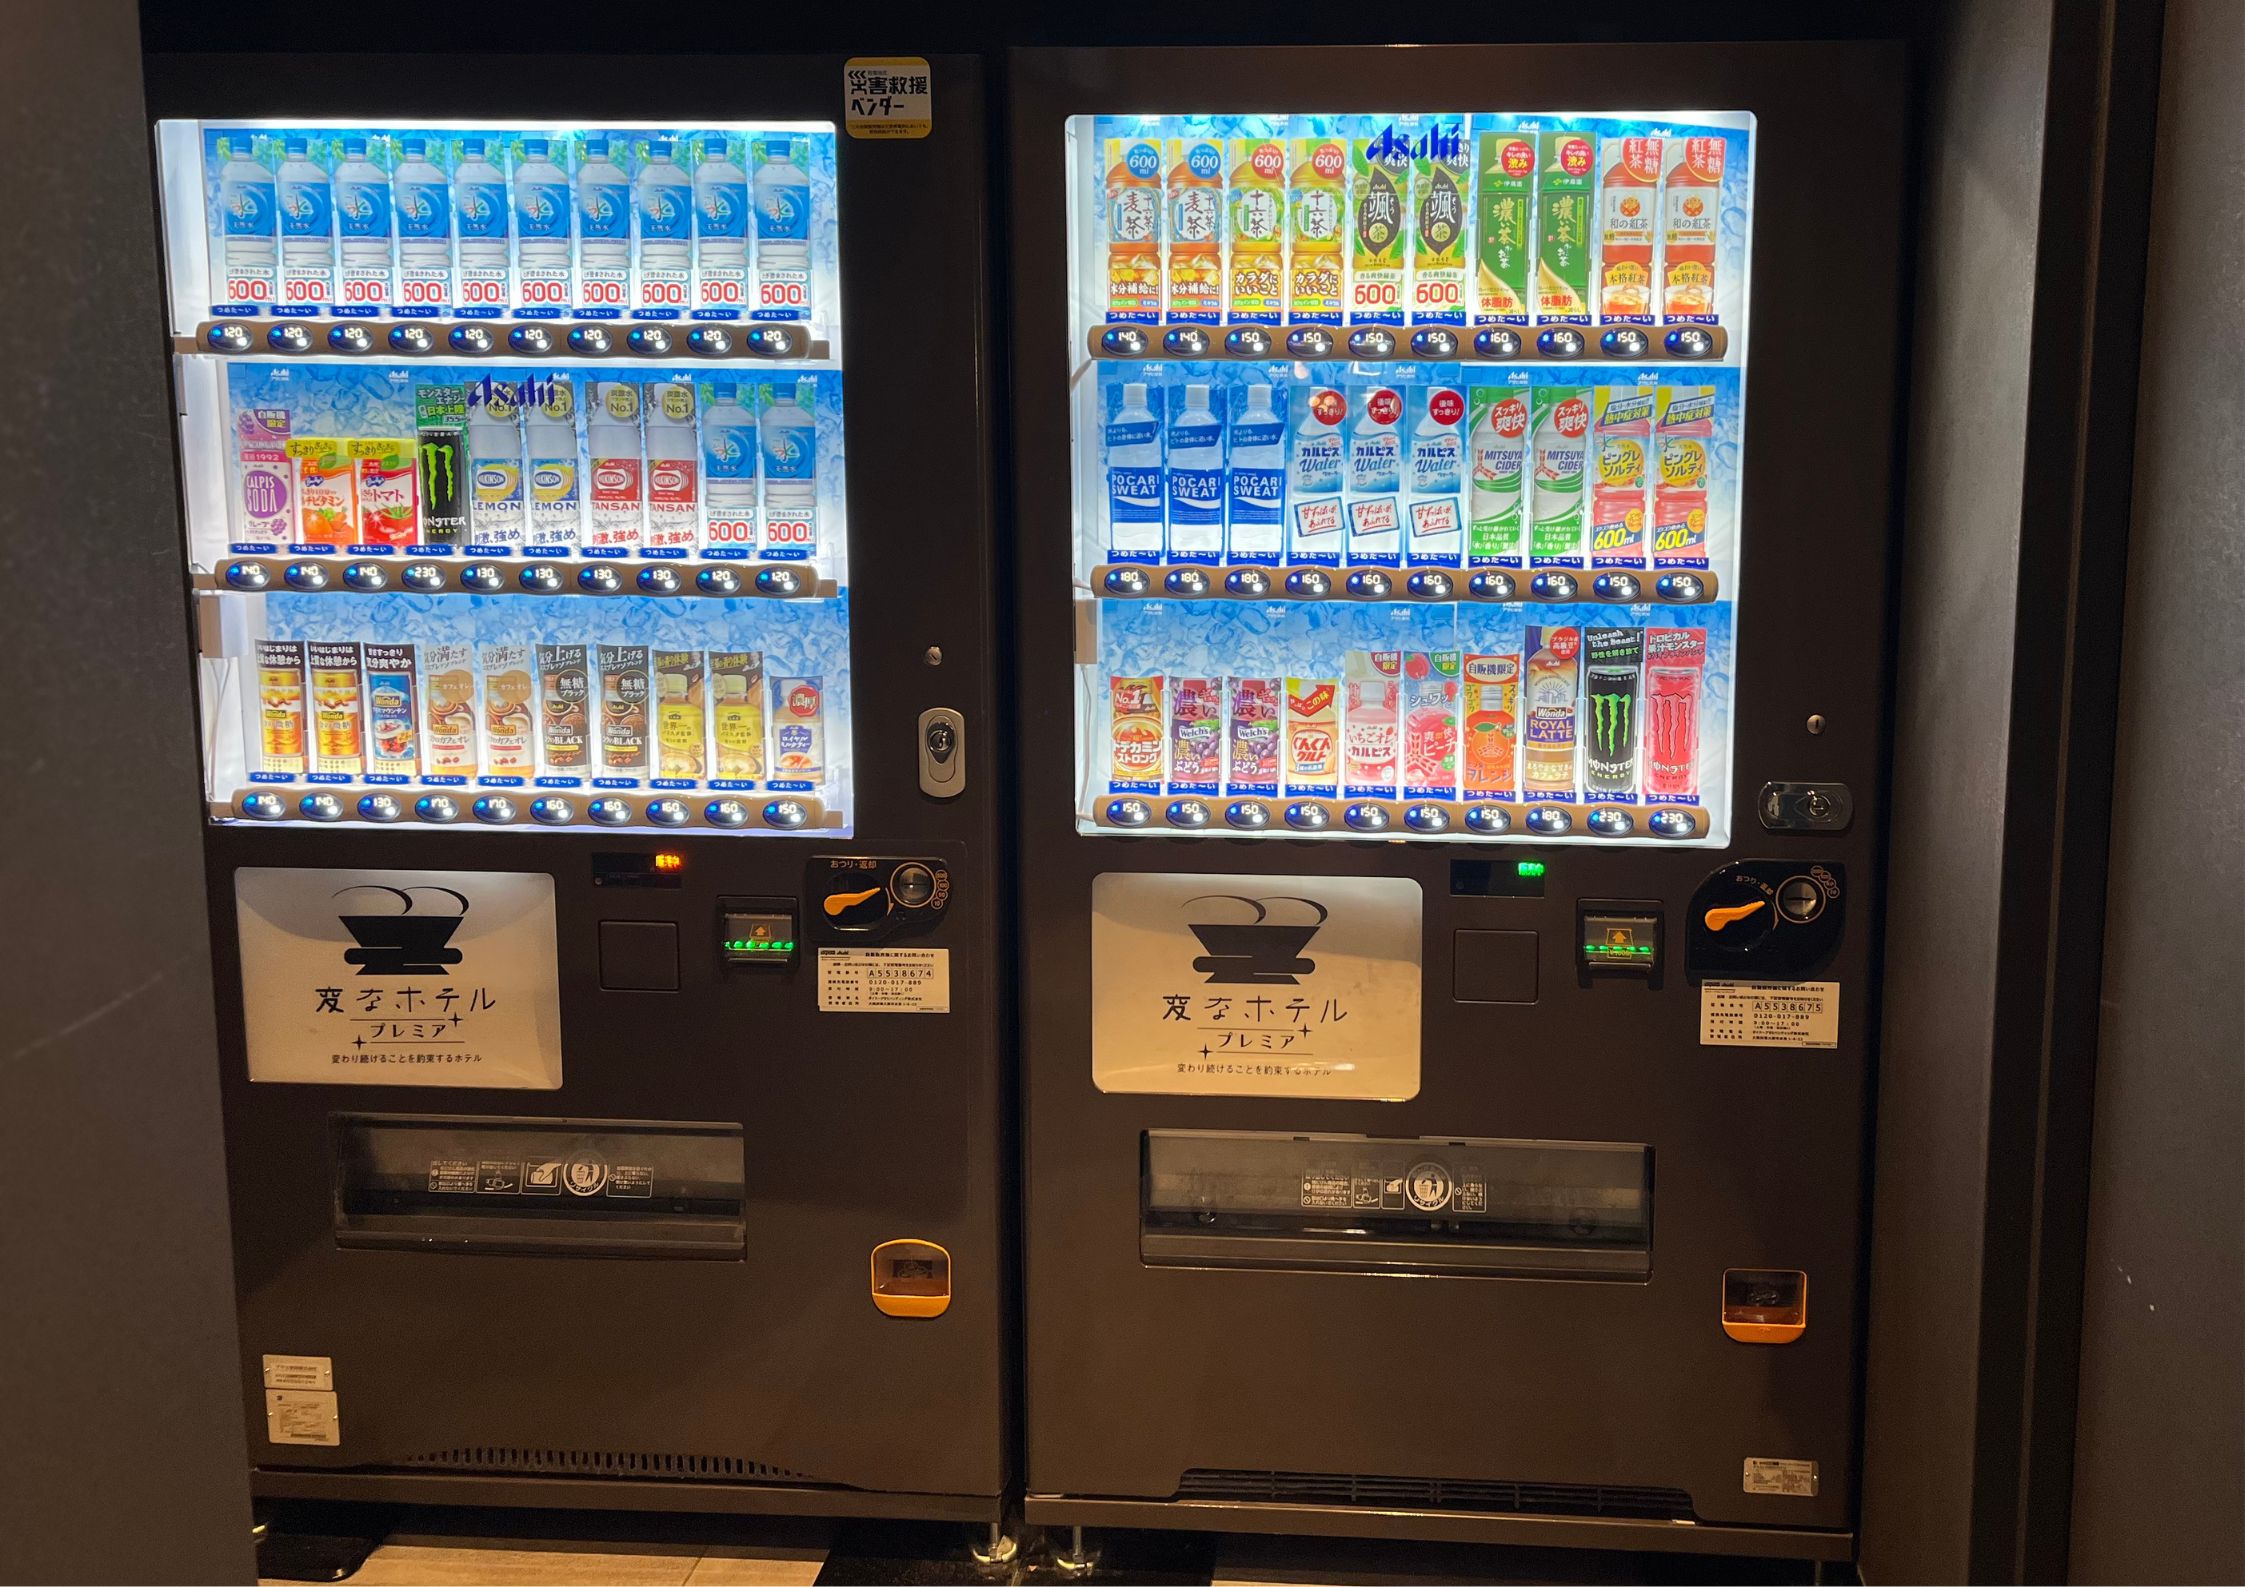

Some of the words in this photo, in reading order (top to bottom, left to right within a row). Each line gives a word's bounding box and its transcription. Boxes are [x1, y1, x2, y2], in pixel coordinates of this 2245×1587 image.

[851, 95, 905, 116] ベンダー
[1366, 122, 1460, 162] Asahi
[1629, 139, 1643, 169] 紅茶
[1645, 139, 1659, 174] 無糖
[1692, 139, 1706, 169] 紅茶
[1707, 139, 1721, 174] 無糖
[1140, 167, 1149, 175] ml
[1201, 167, 1210, 175] ml
[1264, 167, 1274, 175] ml
[1123, 191, 1144, 239] 麦茶
[1185, 191, 1206, 239] 麦茶
[1248, 189, 1268, 238] 十六茶
[1308, 189, 1328, 238] 十六茶
[1610, 218, 1648, 230] 和の紅茶
[1673, 218, 1711, 230] 和の紅茶
[1235, 273, 1278, 285] カラダに
[1295, 273, 1338, 285] カラダに
[1610, 274, 1646, 284] 本格紅茶
[1672, 274, 1708, 284] 本格紅茶
[229, 280, 267, 300] 600
[286, 280, 324, 301] 600
[345, 281, 383, 301] 600
[522, 283, 564, 303] 600
[582, 283, 623, 303] 600
[642, 284, 683, 304] 600
[760, 284, 801, 304] 600
[1235, 284, 1278, 296] いいこと
[1295, 284, 1338, 296] いいこと
[1481, 296, 1513, 308] 体脂肪
[1541, 295, 1573, 306] 体脂肪
[224, 328, 243, 338] 120
[344, 328, 363, 339] 120
[465, 328, 483, 339] 120
[524, 330, 543, 341] 120
[643, 330, 662, 341] 120
[763, 330, 782, 342] 120
[1118, 331, 1136, 342] 140
[1241, 332, 1260, 342] 150
[1365, 333, 1383, 343] 150
[1427, 332, 1446, 343] 150
[1553, 332, 1572, 343] 160
[1681, 332, 1700, 342] 150
[469, 373, 555, 408] Asahi
[610, 403, 633, 413] No.1
[667, 403, 689, 414] No.1
[1494, 402, 1522, 416] スッキリ
[1557, 402, 1584, 416] スッキリ
[1495, 413, 1525, 432] 爽快
[1558, 413, 1587, 432] 爽快
[1301, 447, 1340, 457] カルピス
[1356, 446, 1394, 457] カルピス
[1417, 447, 1456, 458] カルピス
[1484, 450, 1523, 461] MITSUYA
[1546, 450, 1584, 461] MITSUYA
[1602, 449, 1641, 467] ピングレ
[1664, 449, 1702, 467] ピングレ
[1299, 458, 1341, 473] Water
[1354, 458, 1396, 473] Water
[1415, 458, 1457, 473] Water
[1495, 460, 1521, 471] CIDER
[1558, 460, 1583, 471] CIDER
[1604, 462, 1641, 478] ソルティ
[1665, 462, 1703, 478] ソルティ
[1112, 475, 1160, 486] POCARI
[1172, 476, 1221, 488] POCARI
[1233, 475, 1282, 487] POCARI
[373, 490, 405, 502] トマト
[1112, 485, 1156, 496] SWEAT
[1172, 487, 1217, 498] SWEAT
[1233, 486, 1278, 497] SWEAT
[246, 488, 275, 513] SODA
[473, 501, 521, 511] LEMON
[591, 502, 640, 511] TANSAN
[709, 522, 748, 542] 600
[768, 522, 807, 543] 600
[1593, 527, 1635, 551] 600ml
[1655, 527, 1697, 551] 600ml
[242, 565, 260, 575] 140
[359, 566, 378, 577] 140
[476, 567, 495, 578] 130
[535, 569, 553, 580] 130
[652, 569, 671, 581] 130
[771, 571, 789, 582] 120
[1120, 572, 1138, 582] 180
[1241, 574, 1259, 584] 180
[1363, 575, 1380, 585] 160
[1424, 576, 1442, 586] 160
[1548, 576, 1566, 586] 160
[1673, 577, 1692, 587] 150
[1587, 630, 1624, 643] Unleash
[1592, 639, 1608, 648] the
[1468, 662, 1514, 676] 自販機限定
[560, 677, 584, 690] 無糖
[621, 678, 645, 690] 無糖
[560, 689, 584, 697] ブラック
[621, 690, 645, 698] ブラック
[1537, 708, 1566, 718] Wonda
[1530, 719, 1573, 730] ROYAL
[1180, 726, 1209, 737] Welch's
[1238, 727, 1268, 738] Welch's
[1530, 729, 1573, 740] LATTE
[1351, 746, 1392, 757] カルピス
[1424, 736, 1456, 756] ピーチ
[1117, 753, 1157, 764] ストロング
[1174, 760, 1200, 773] ぶどう
[1232, 760, 1258, 774] ぶどう
[1122, 803, 1140, 813] 150
[1241, 805, 1259, 815] 150
[1361, 807, 1378, 817] 150
[1420, 808, 1438, 819] 150
[1542, 811, 1560, 821] 180
[1661, 813, 1683, 822] 230
[315, 987, 496, 1014] 変なホテル
[1162, 993, 1348, 1023] 変なホテル
[369, 1024, 446, 1039] プレミア
[1217, 1032, 1295, 1049] プレミア
[331, 1053, 482, 1064] 変わり続けることを約束するホテル
